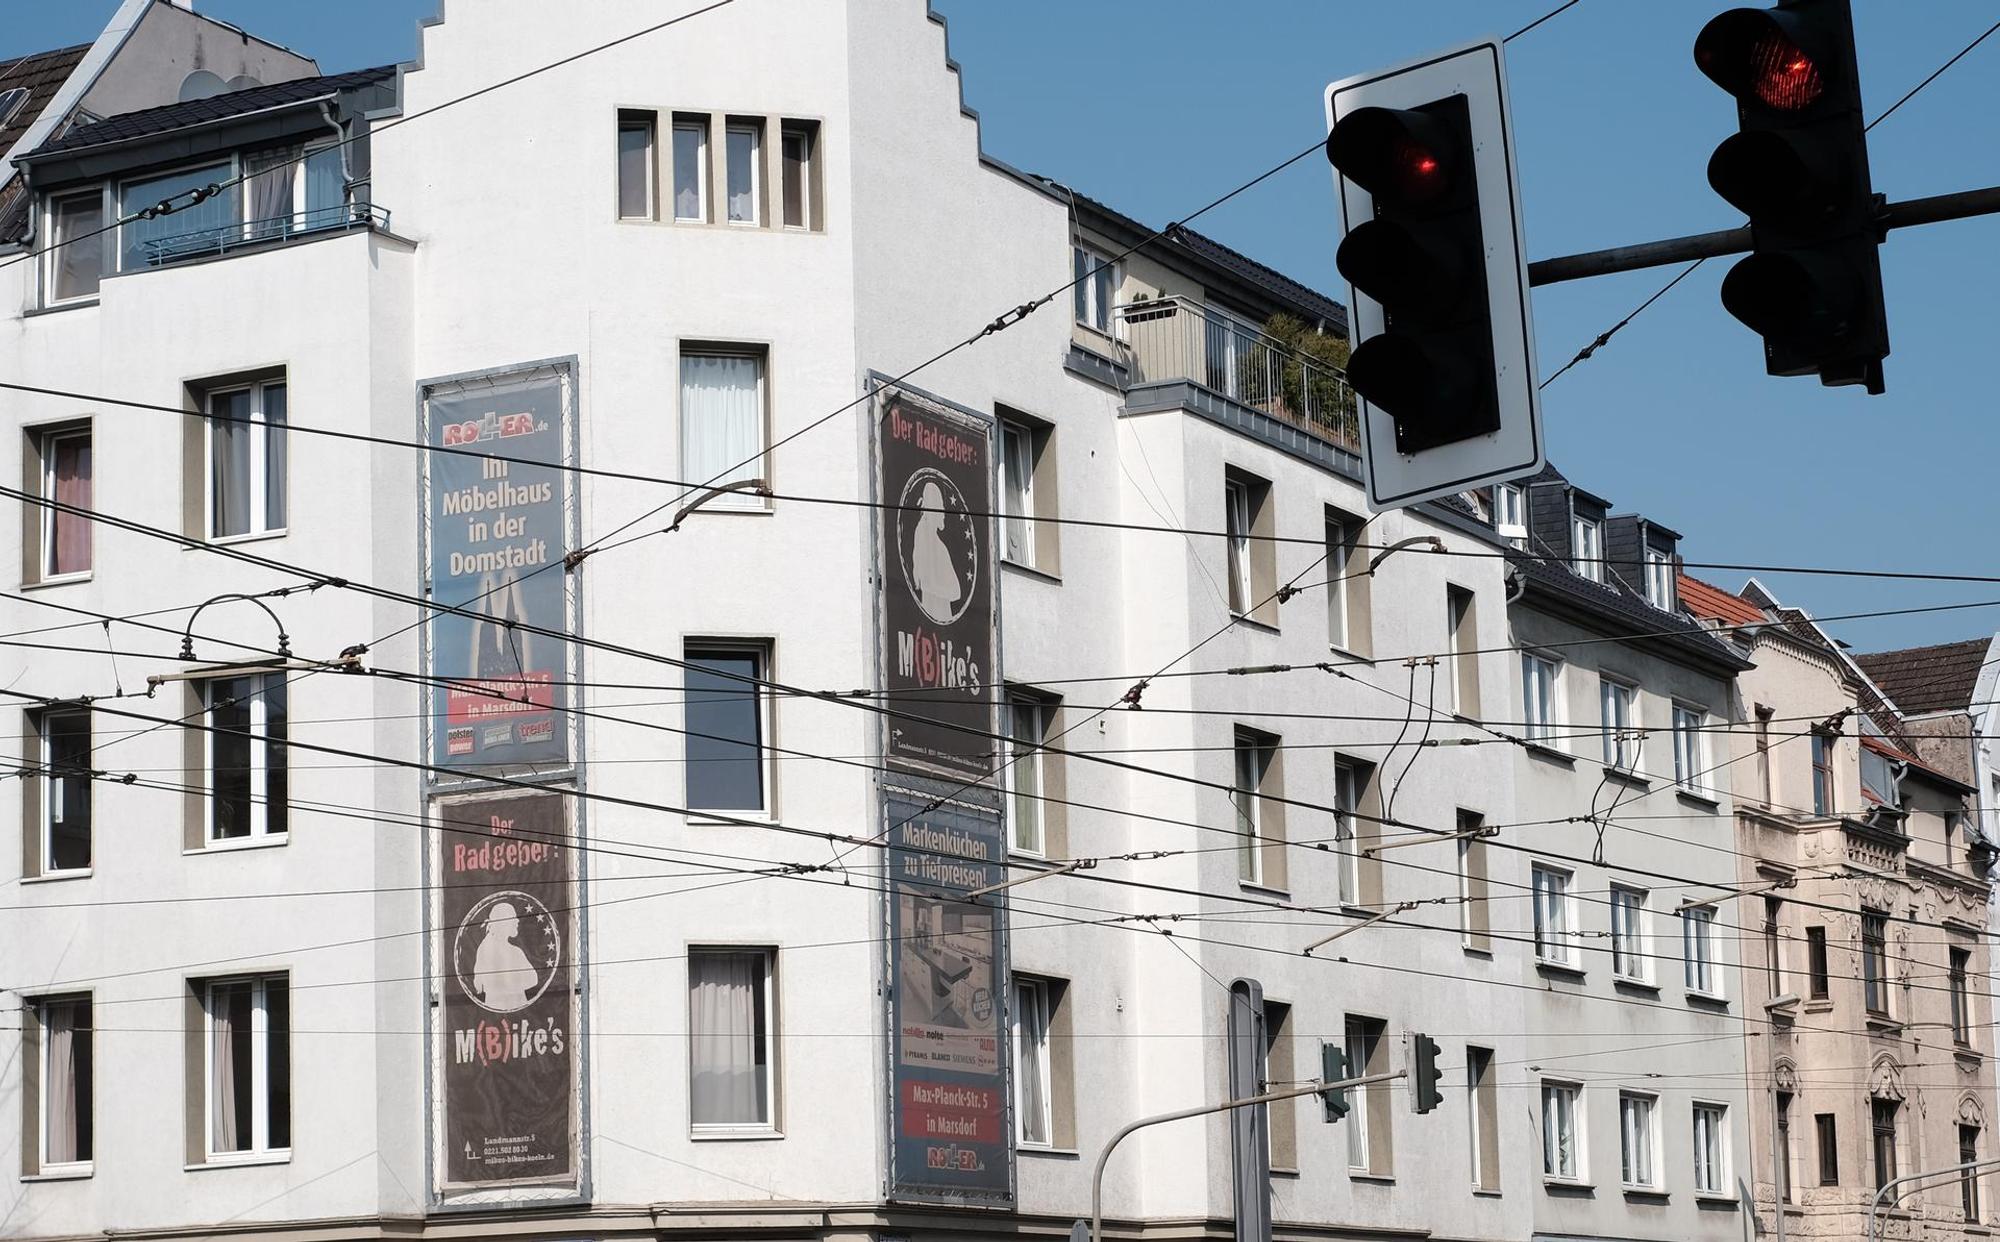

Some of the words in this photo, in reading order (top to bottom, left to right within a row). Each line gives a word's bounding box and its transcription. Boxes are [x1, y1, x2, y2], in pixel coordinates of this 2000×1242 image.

[891, 408, 912, 443] Der
[483, 453, 508, 480] Ihr
[442, 481, 551, 516] Möbelhaus
[468, 517, 488, 543] in
[493, 512, 526, 540] der
[450, 538, 546, 576] Domstadt
[467, 705, 479, 718] in
[482, 697, 533, 717] Marsdorf
[491, 815, 514, 836] Der
[902, 822, 987, 859] Markenküchen
[904, 856, 918, 876] zu
[921, 854, 987, 888] Tiefpreisen!
[913, 1085, 981, 1108] Max-Planck-Str.
[983, 1093, 989, 1109] 5
[927, 1114, 935, 1132] in
[938, 1116, 977, 1136] Marsdorf
